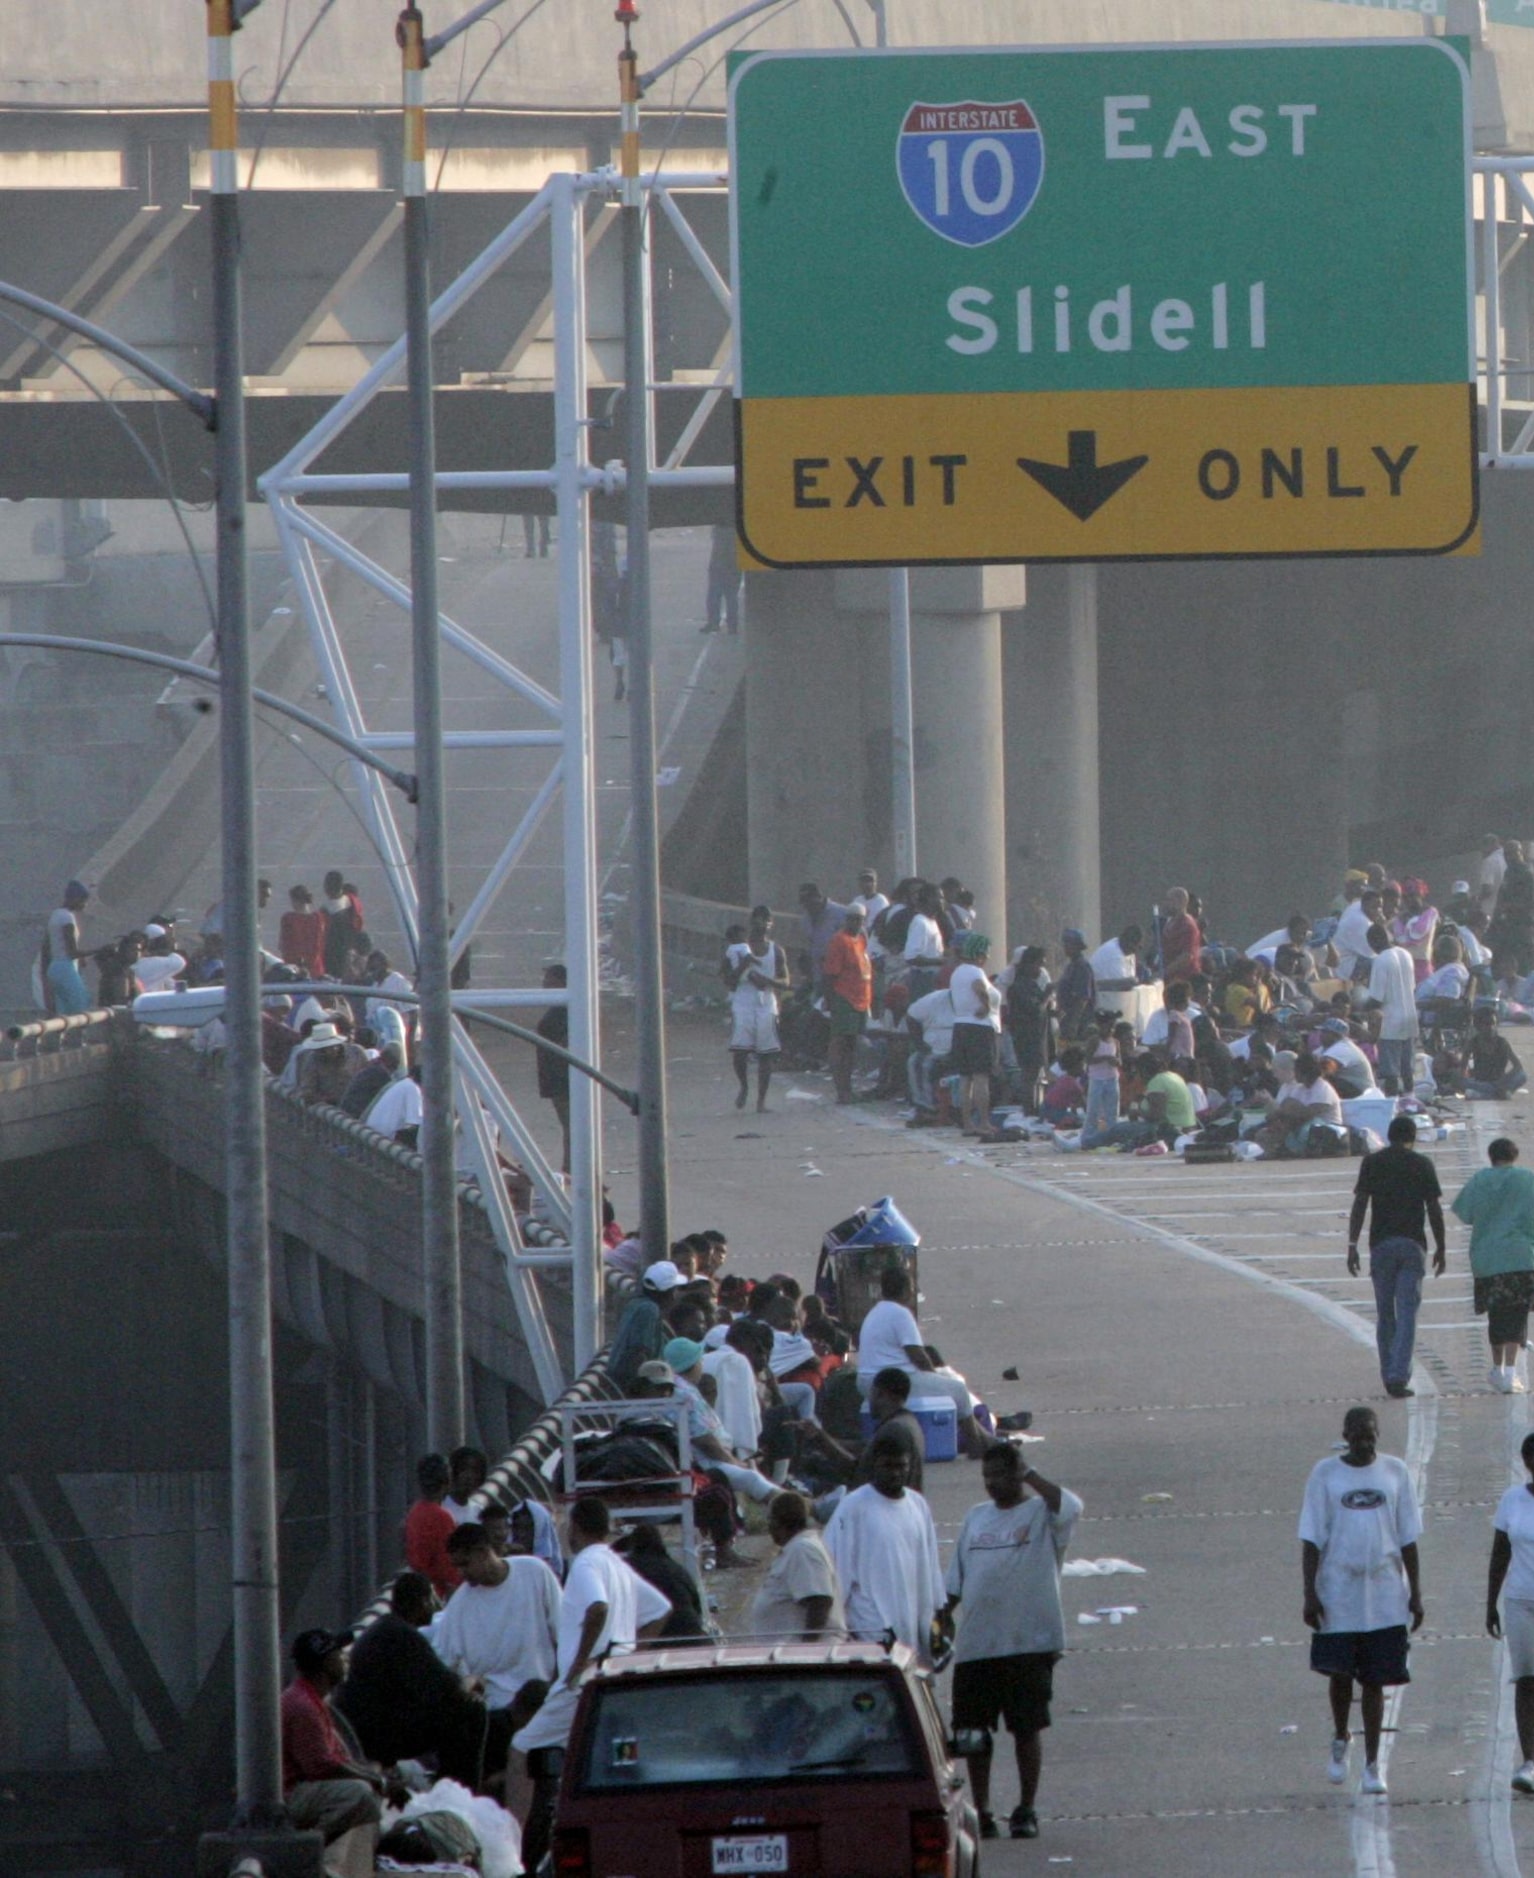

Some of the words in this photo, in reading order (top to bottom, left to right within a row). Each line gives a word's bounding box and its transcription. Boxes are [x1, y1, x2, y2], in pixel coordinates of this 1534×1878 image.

[920, 109, 1019, 130] INTERSTATE
[1103, 95, 1318, 159] EAST
[928, 138, 1014, 217] 10
[945, 281, 1267, 356] Slidell
[792, 454, 968, 509] EXIT
[1197, 445, 1419, 502] ONLY
